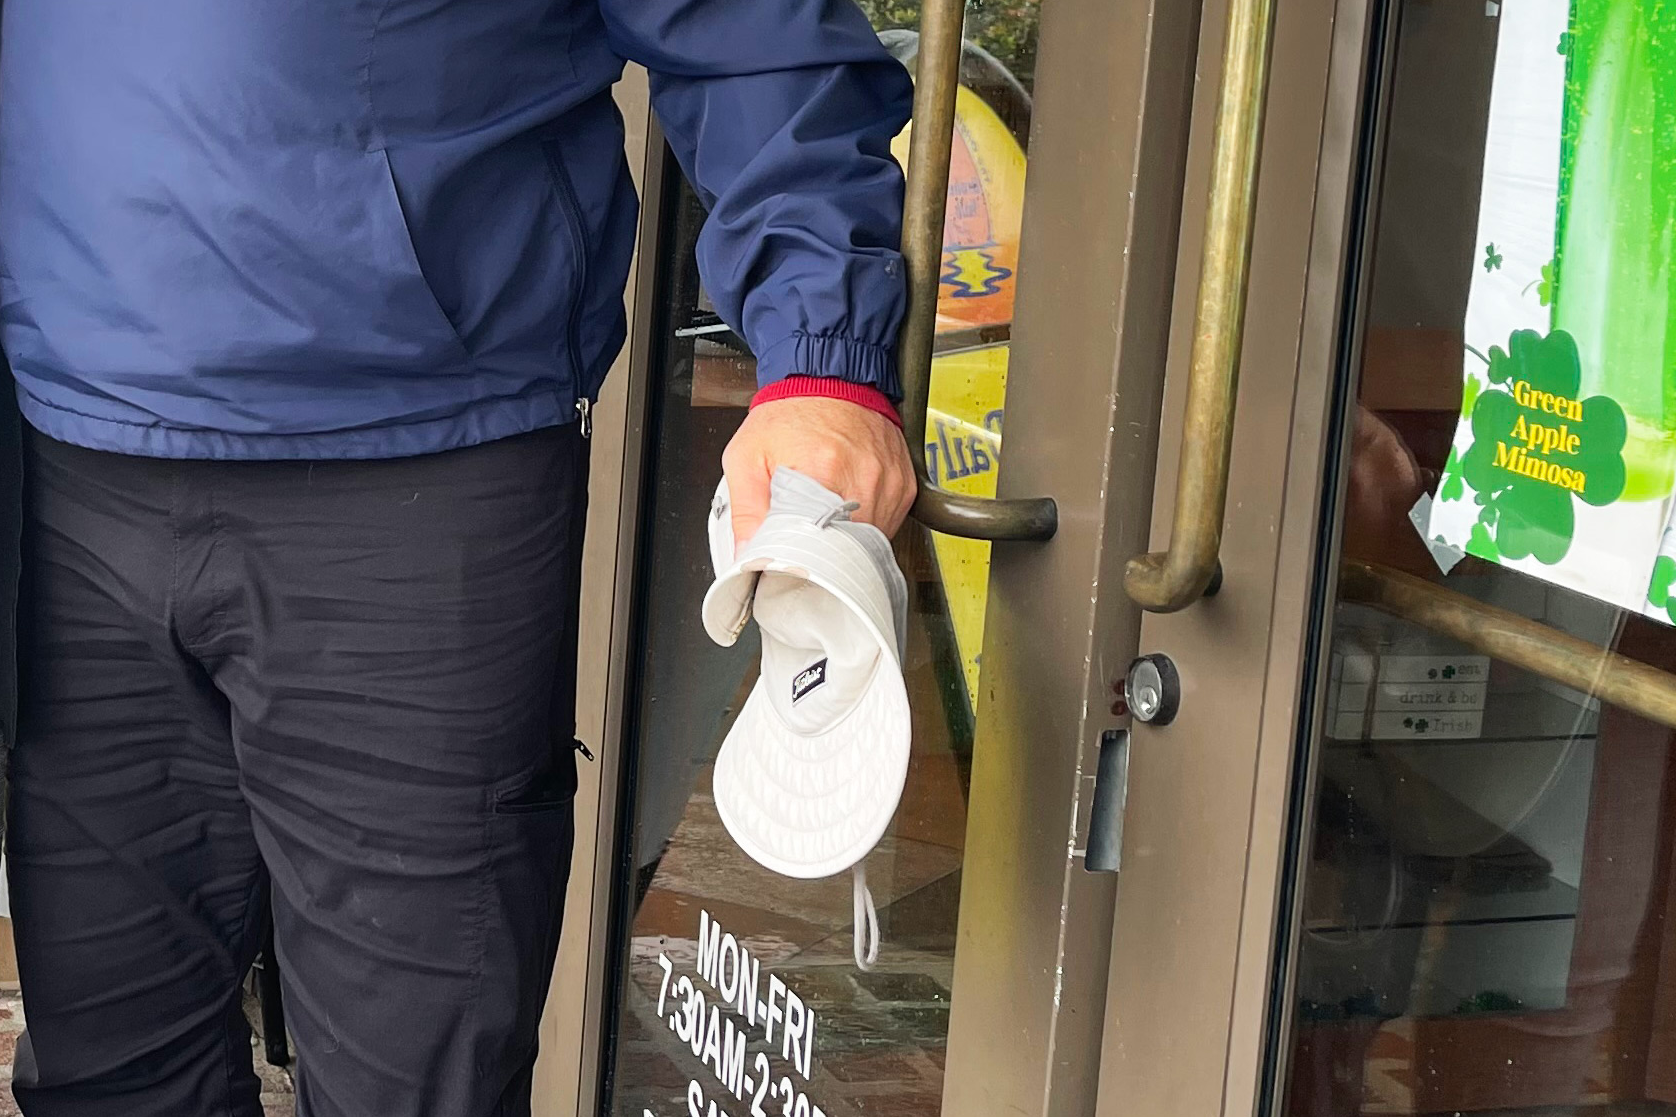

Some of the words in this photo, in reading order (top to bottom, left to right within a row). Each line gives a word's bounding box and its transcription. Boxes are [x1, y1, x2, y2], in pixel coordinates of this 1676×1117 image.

[1513, 380, 1583, 422] Green
[1510, 414, 1581, 455] Apple
[1492, 441, 1587, 494] Mimosa
[1400, 691, 1442, 704] drink
[1447, 695, 1458, 704] &
[1433, 718, 1473, 732] Irish
[696, 909, 816, 1081] MON-FRI
